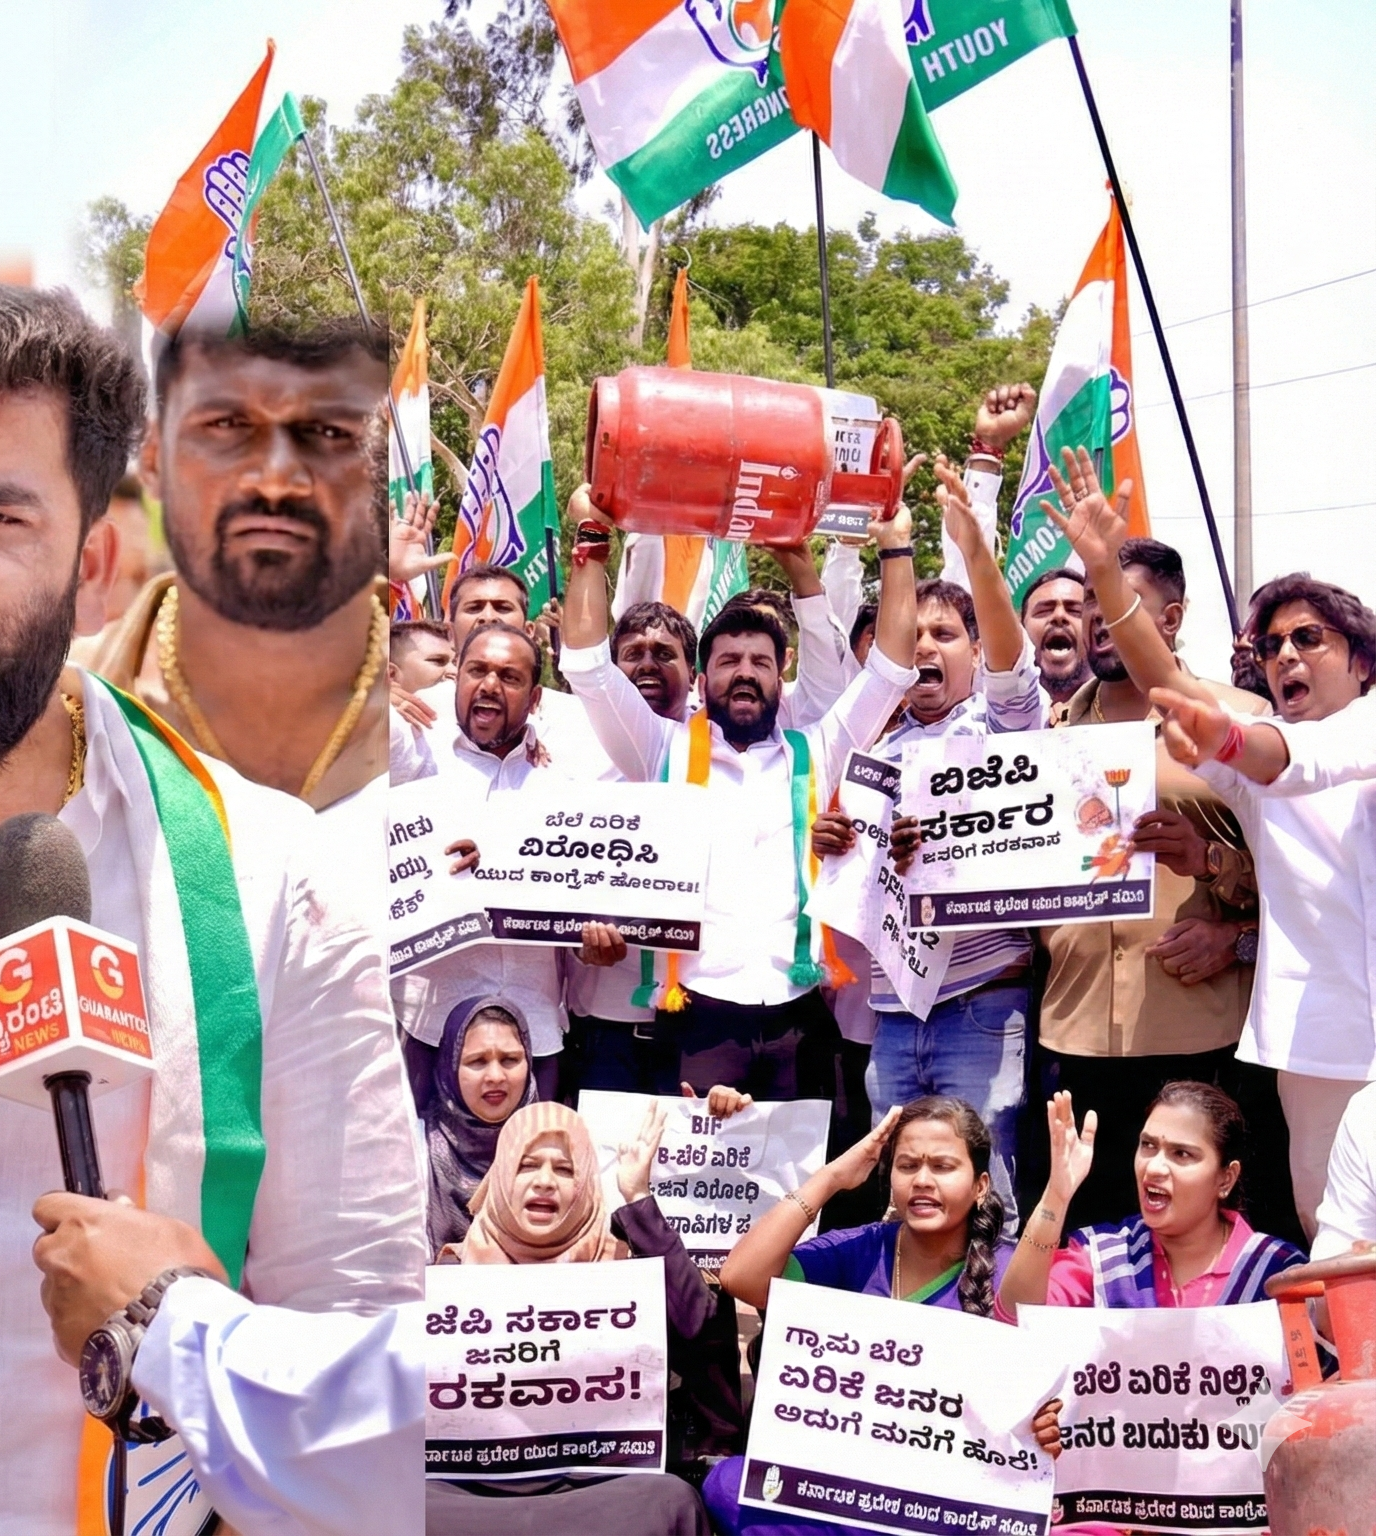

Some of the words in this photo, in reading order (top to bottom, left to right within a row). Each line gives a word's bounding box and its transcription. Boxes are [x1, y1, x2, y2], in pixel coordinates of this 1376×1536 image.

[930, 754, 1039, 796] ಬಿಜೆಪಿ
[921, 793, 1054, 843] ಸರ್ಕಾರ
[14, 1022, 60, 1054] NEWS
[506, 1301, 637, 1333] ಸರ್ಕಾರ
[465, 1339, 561, 1365] ಜನರಿಗೆ
[869, 1339, 923, 1367] ಬೆಲೆ
[429, 1366, 641, 1410] ರಕವಾಸ!
[1073, 1361, 1121, 1396] ಬೆಲೆ
[1128, 1361, 1191, 1396] ಏರಿಕೆ
[1122, 1416, 1209, 1450] ಬದುಕು
